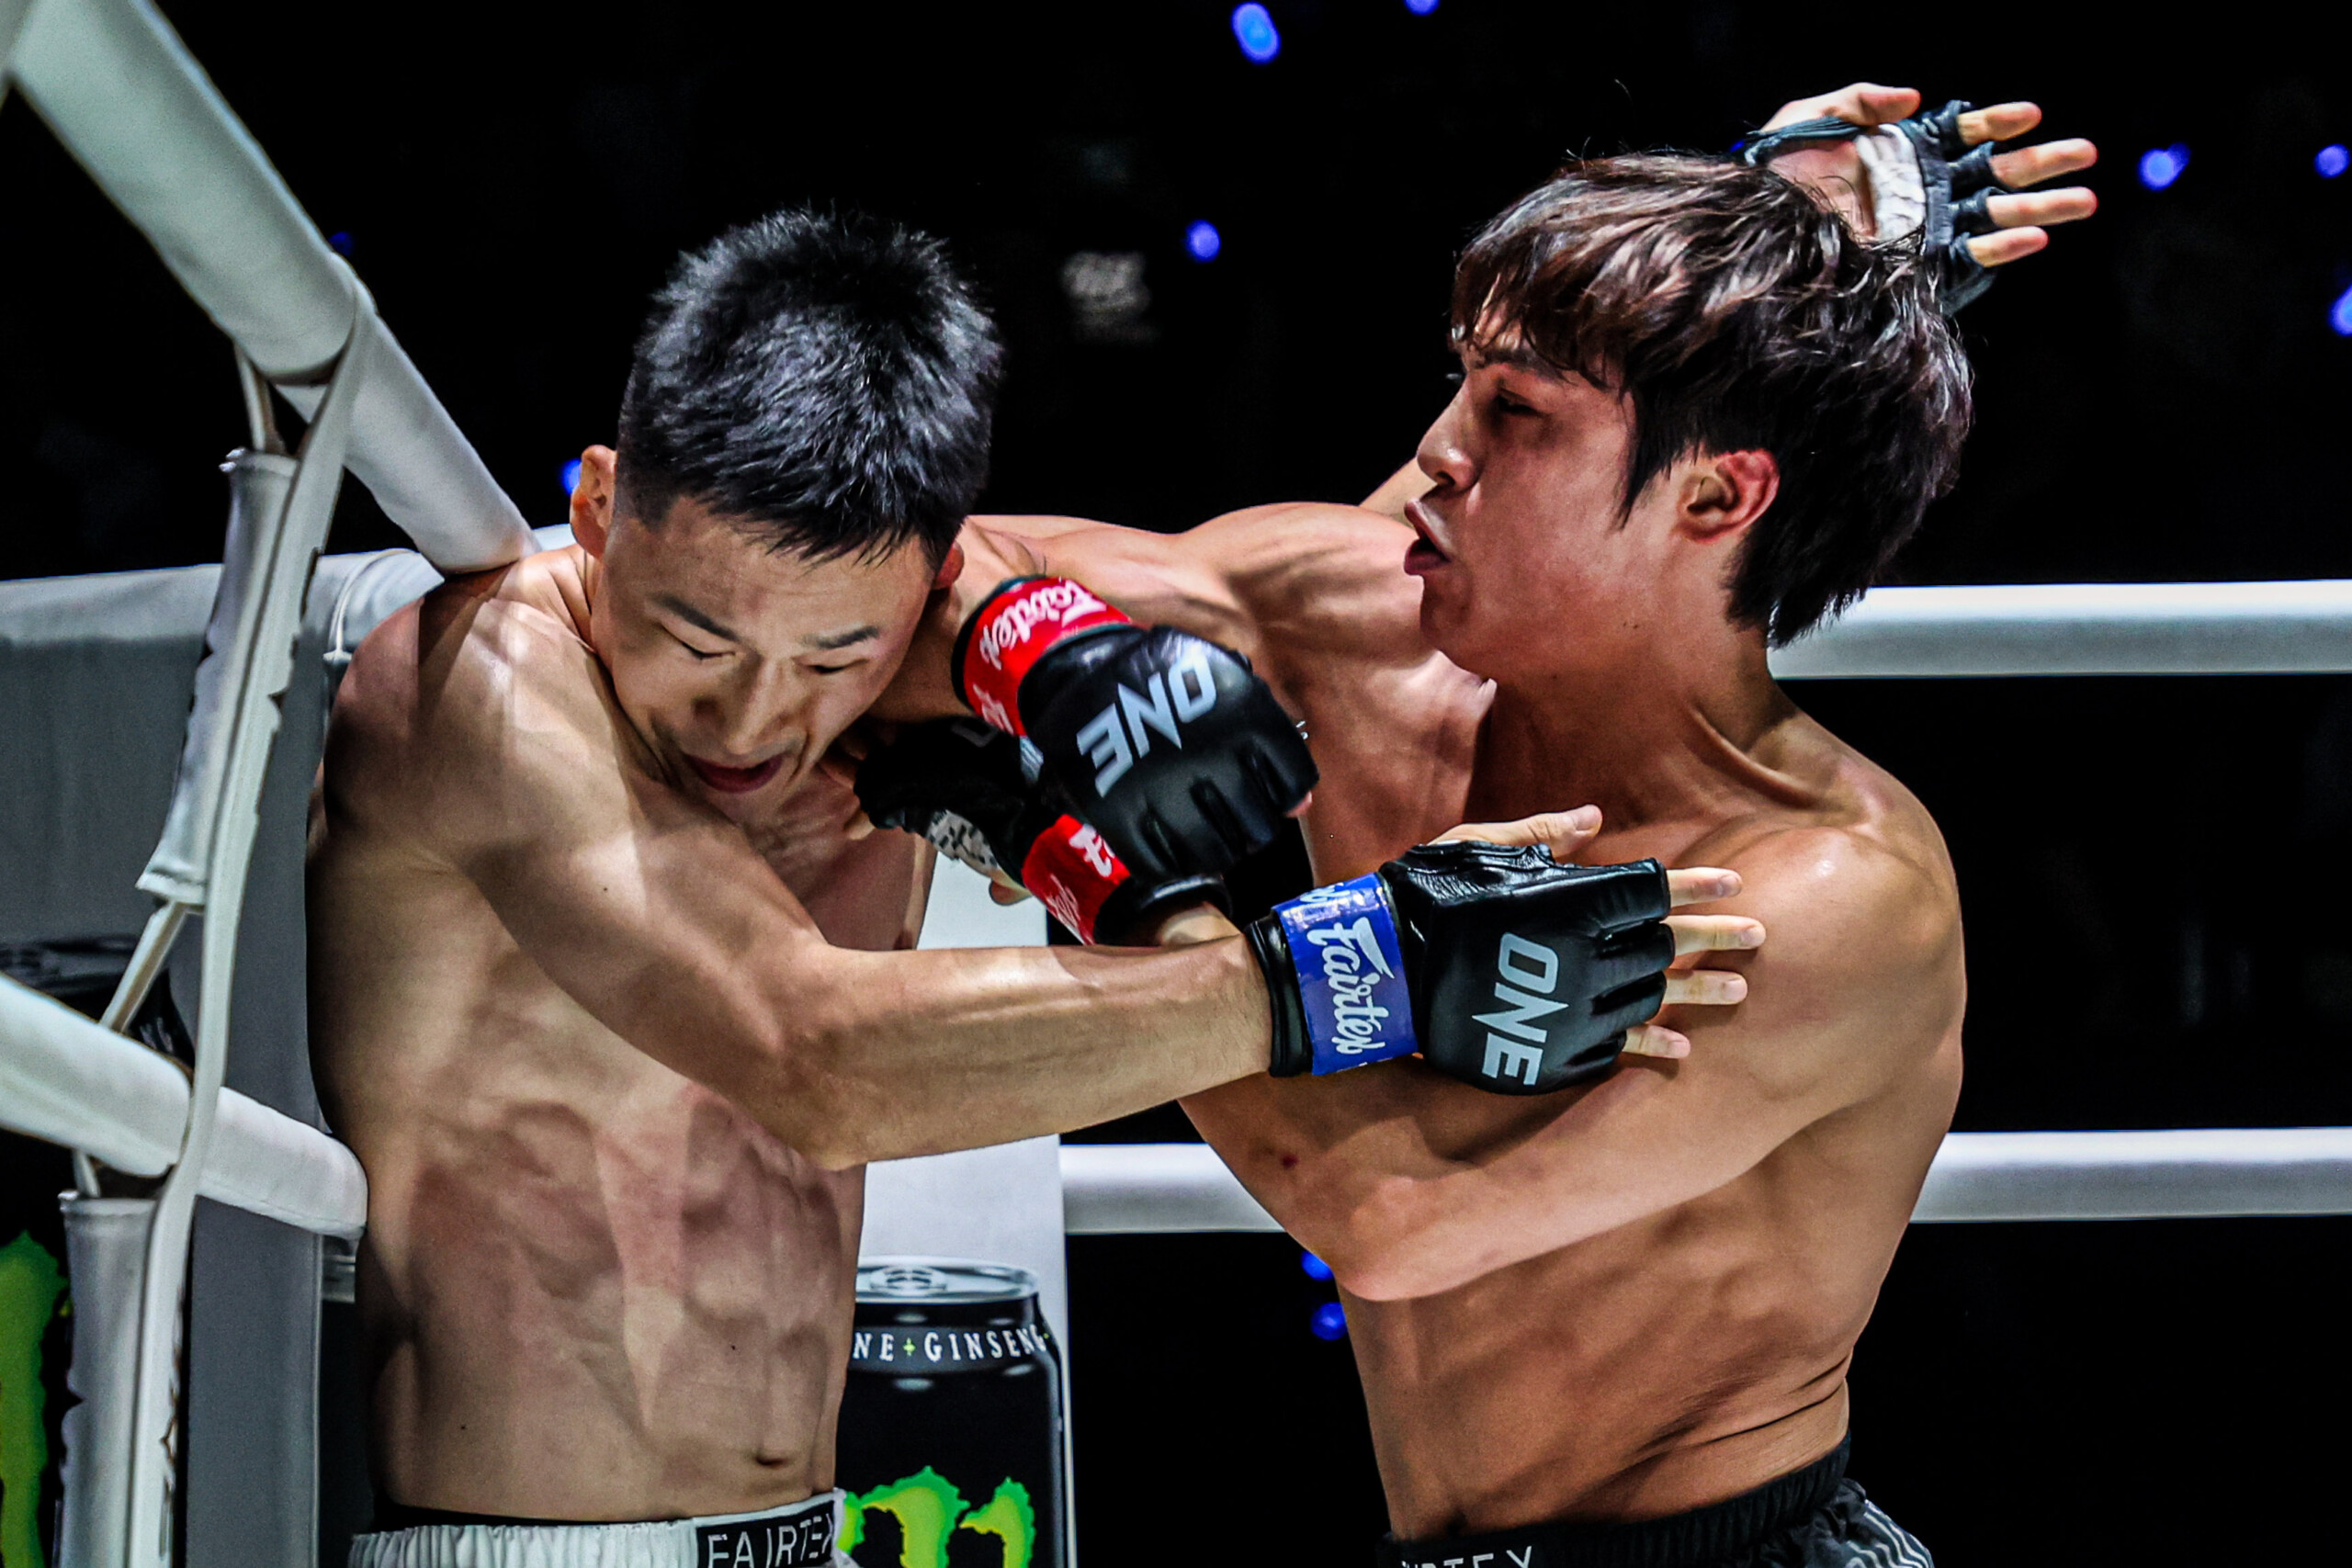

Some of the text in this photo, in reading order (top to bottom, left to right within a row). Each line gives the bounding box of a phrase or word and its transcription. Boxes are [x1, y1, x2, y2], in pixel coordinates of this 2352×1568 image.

[1076, 642, 1217, 799] ONE
[1306, 916, 1396, 1055] Fairtex
[1471, 931, 1569, 1087] ONE
[923, 1324, 1047, 1363] GINSENG
